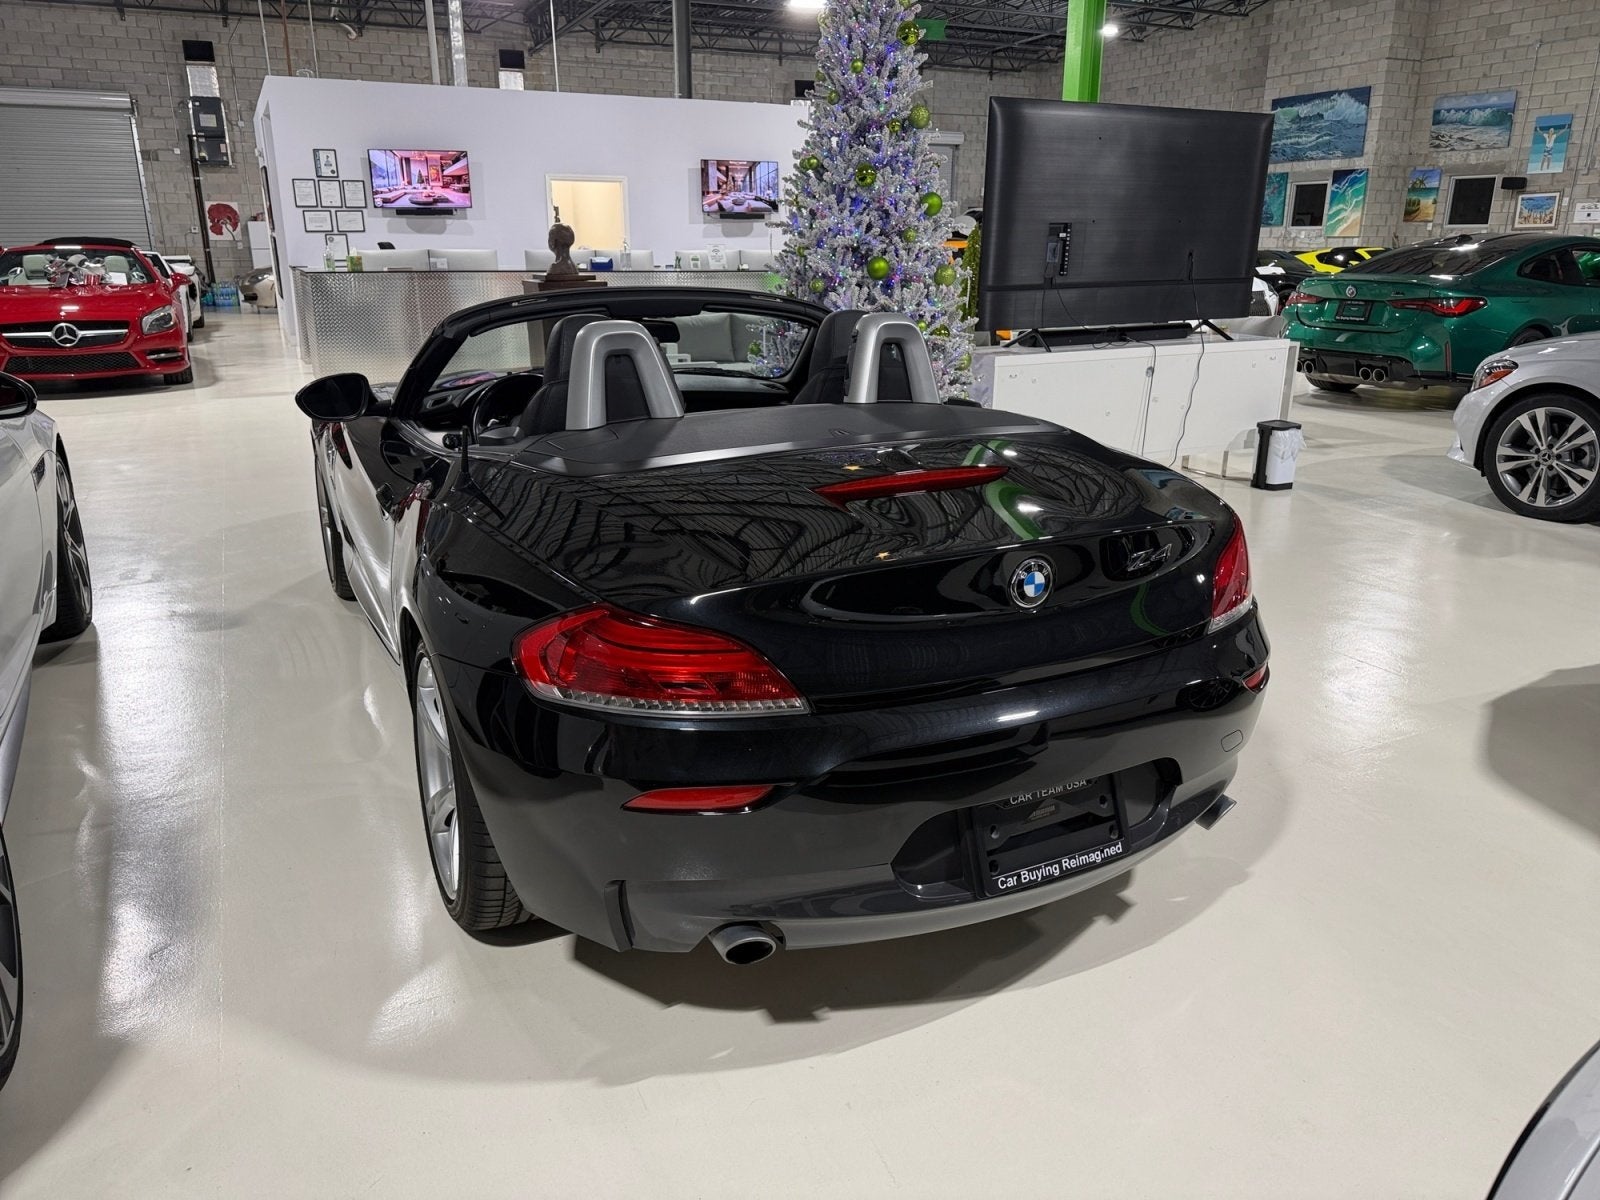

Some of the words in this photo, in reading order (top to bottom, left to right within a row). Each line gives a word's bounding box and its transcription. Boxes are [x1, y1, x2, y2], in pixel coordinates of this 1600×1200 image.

[1020, 563, 1049, 579] BMW
[1009, 792, 1033, 805] CAR
[997, 876, 1018, 890] Car
[1020, 864, 1060, 883] Buying
